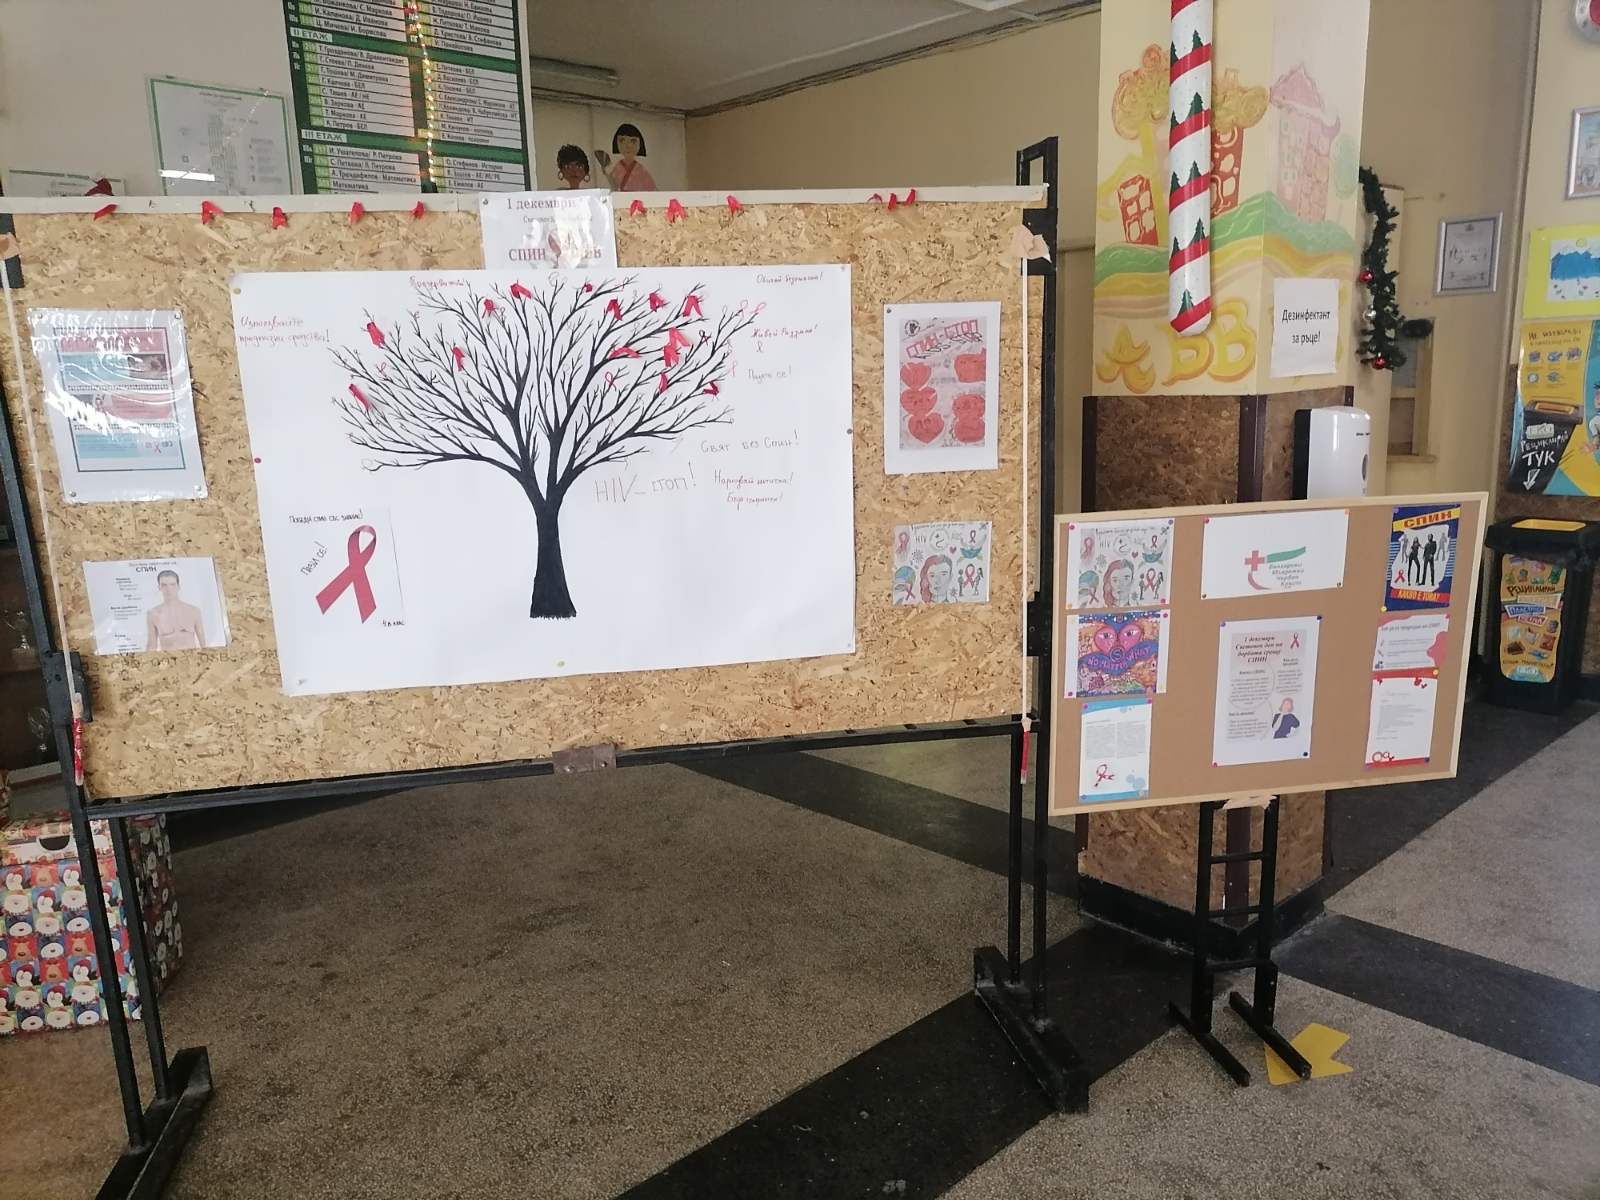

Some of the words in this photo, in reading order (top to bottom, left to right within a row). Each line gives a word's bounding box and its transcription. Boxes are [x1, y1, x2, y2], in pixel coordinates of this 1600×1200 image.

[316, 132, 343, 141] ЕТАЖ
[508, 248, 546, 262] СПИН
[1281, 307, 1330, 324] Дезинфектант
[1291, 333, 1300, 344] за
[1301, 330, 1321, 346] ръце!
[701, 440, 730, 453] Свят
[1522, 450, 1556, 467] ТУК
[1403, 511, 1452, 528] СПИН
